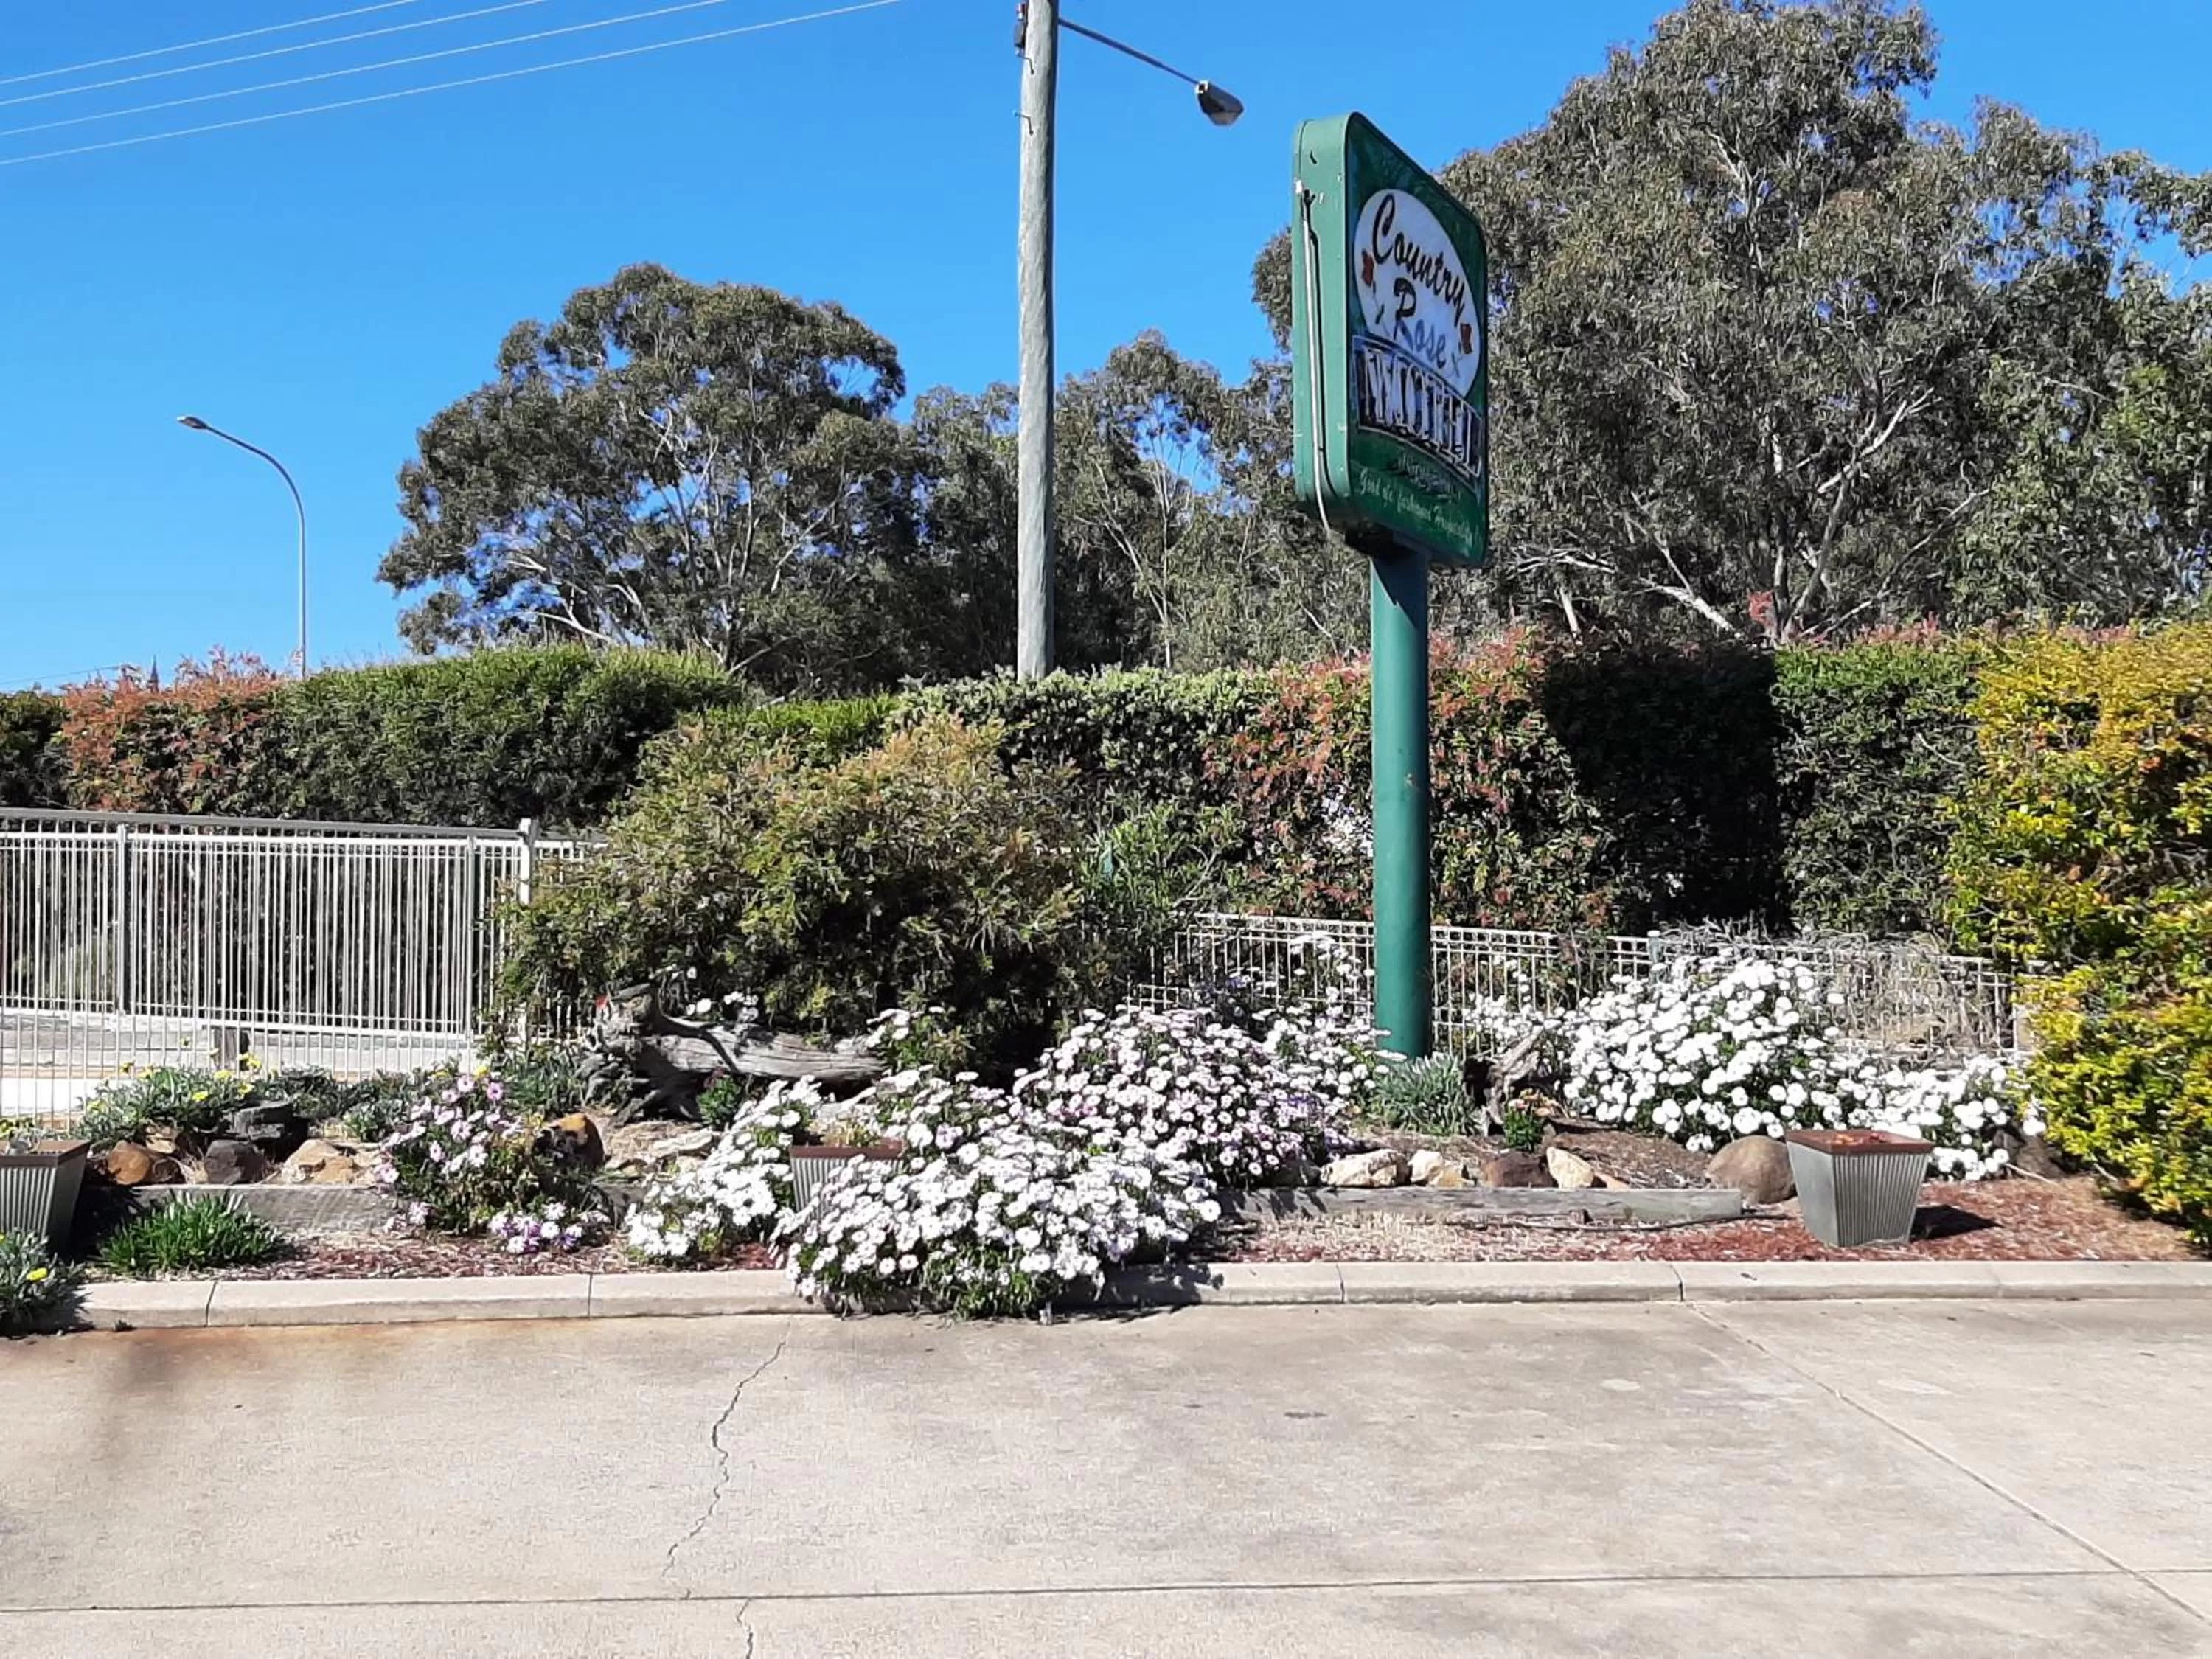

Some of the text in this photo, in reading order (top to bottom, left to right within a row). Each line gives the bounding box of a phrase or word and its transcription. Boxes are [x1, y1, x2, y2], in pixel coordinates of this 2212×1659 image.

[1372, 194, 1465, 327] Country
[1393, 277, 1447, 369] Rose
[1363, 347, 1482, 478] MOTEL
